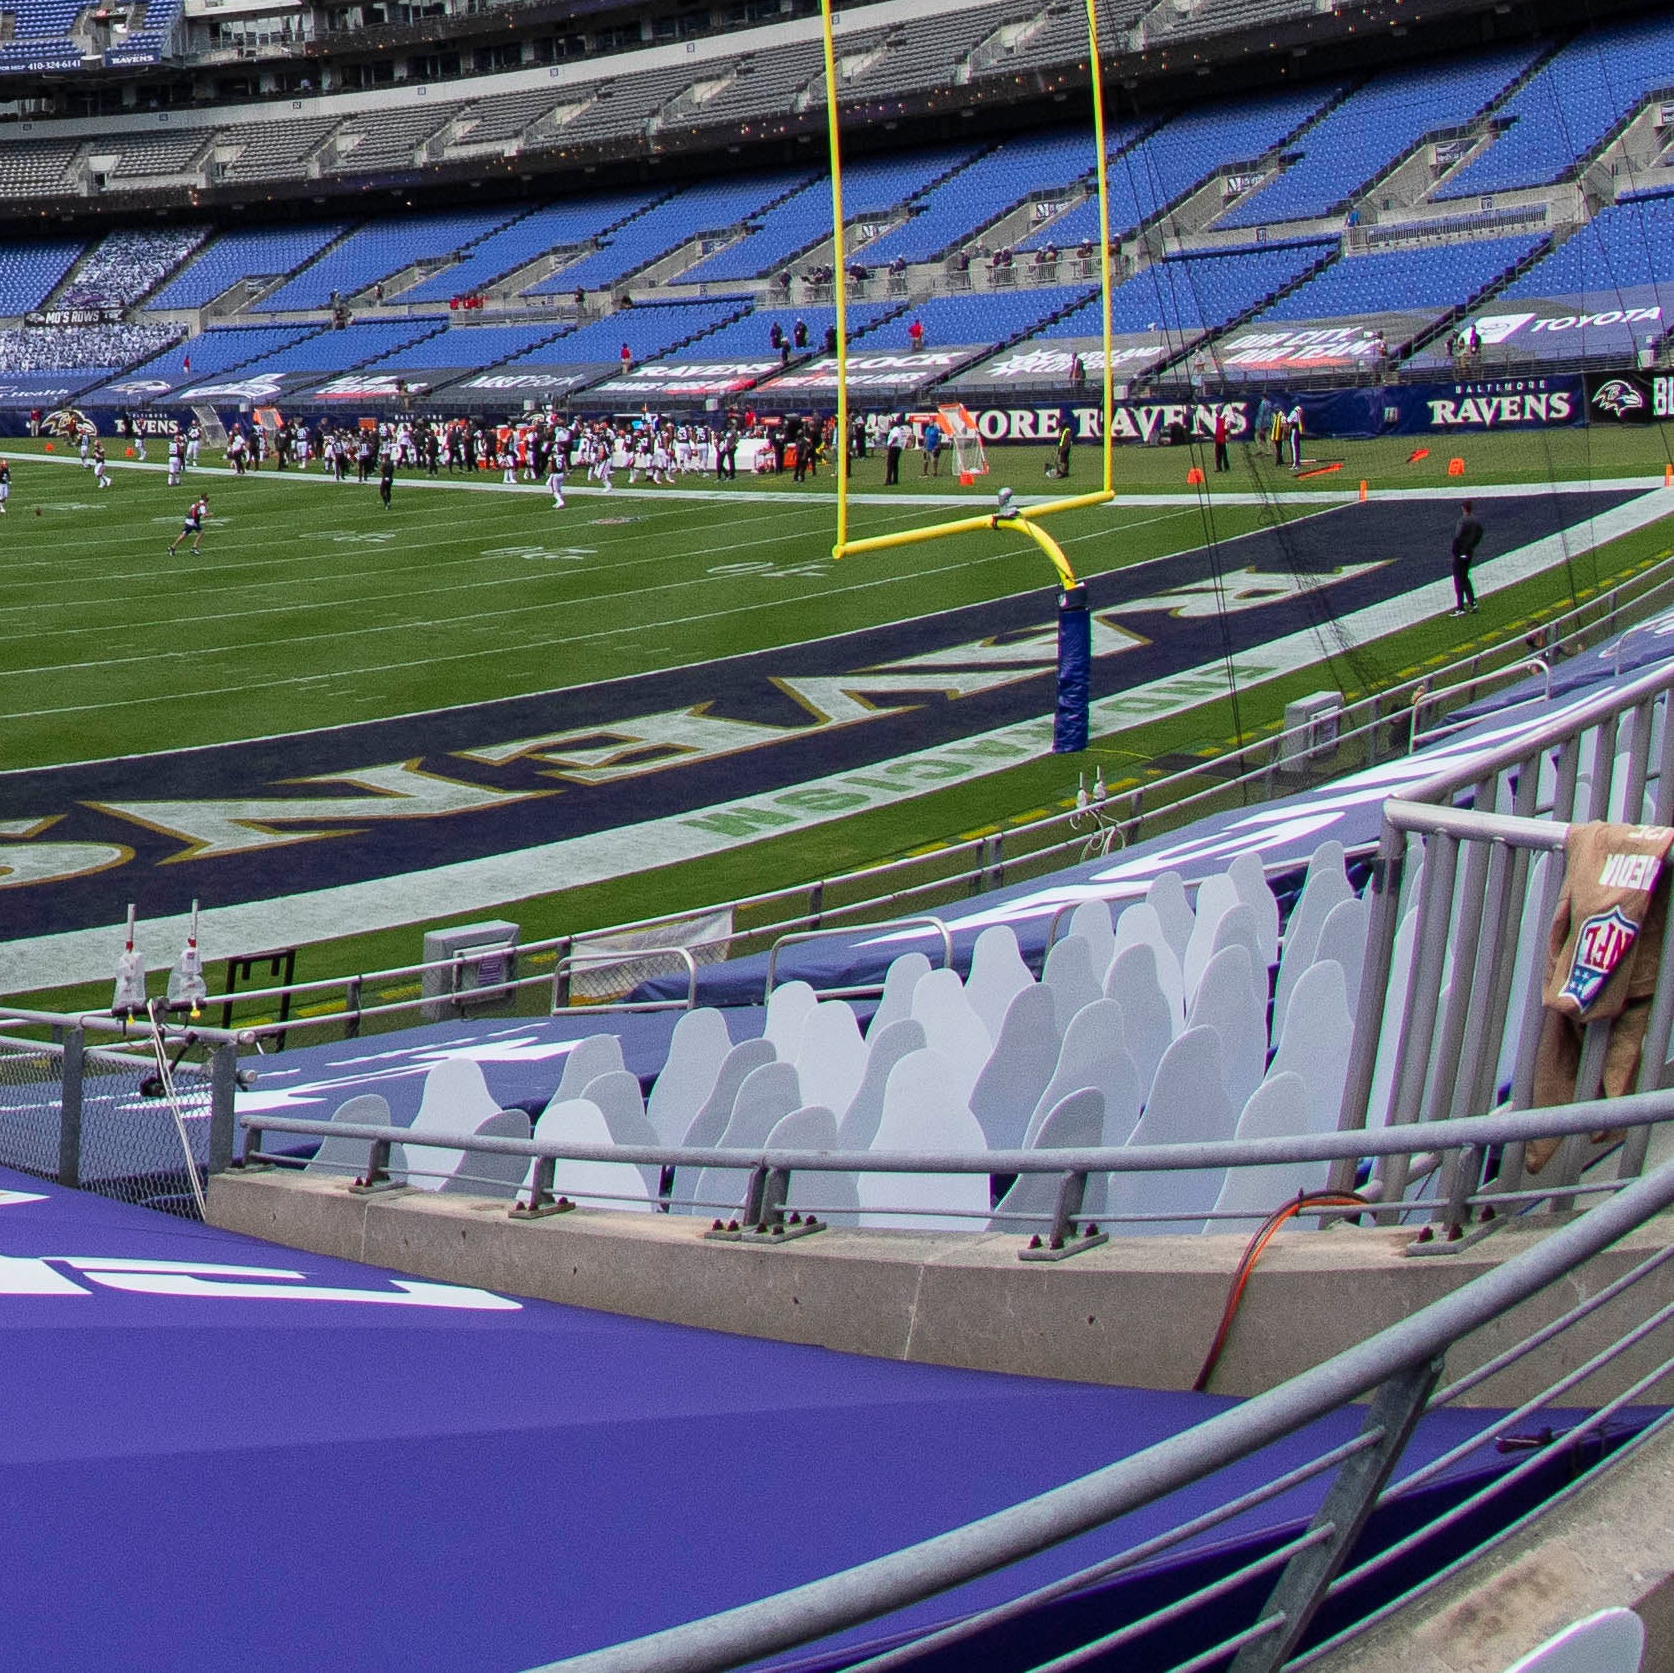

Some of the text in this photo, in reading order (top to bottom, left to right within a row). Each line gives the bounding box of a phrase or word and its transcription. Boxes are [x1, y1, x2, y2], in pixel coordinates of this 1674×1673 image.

[27, 59, 82, 70] 410-324-6141
[111, 54, 155, 65] RAVENS
[45, 311, 70, 324] MO'S
[71, 309, 100, 323] ROWS
[1529, 306, 1665, 334] TOYOTA
[630, 362, 783, 377] RAVENS
[10, 388, 69, 399] Health
[1454, 379, 1548, 395] BALTIMORE
[1427, 391, 1574, 427] RAVENS
[1099, 663, 1285, 717] END
[1581, 922, 1637, 973] NFL
